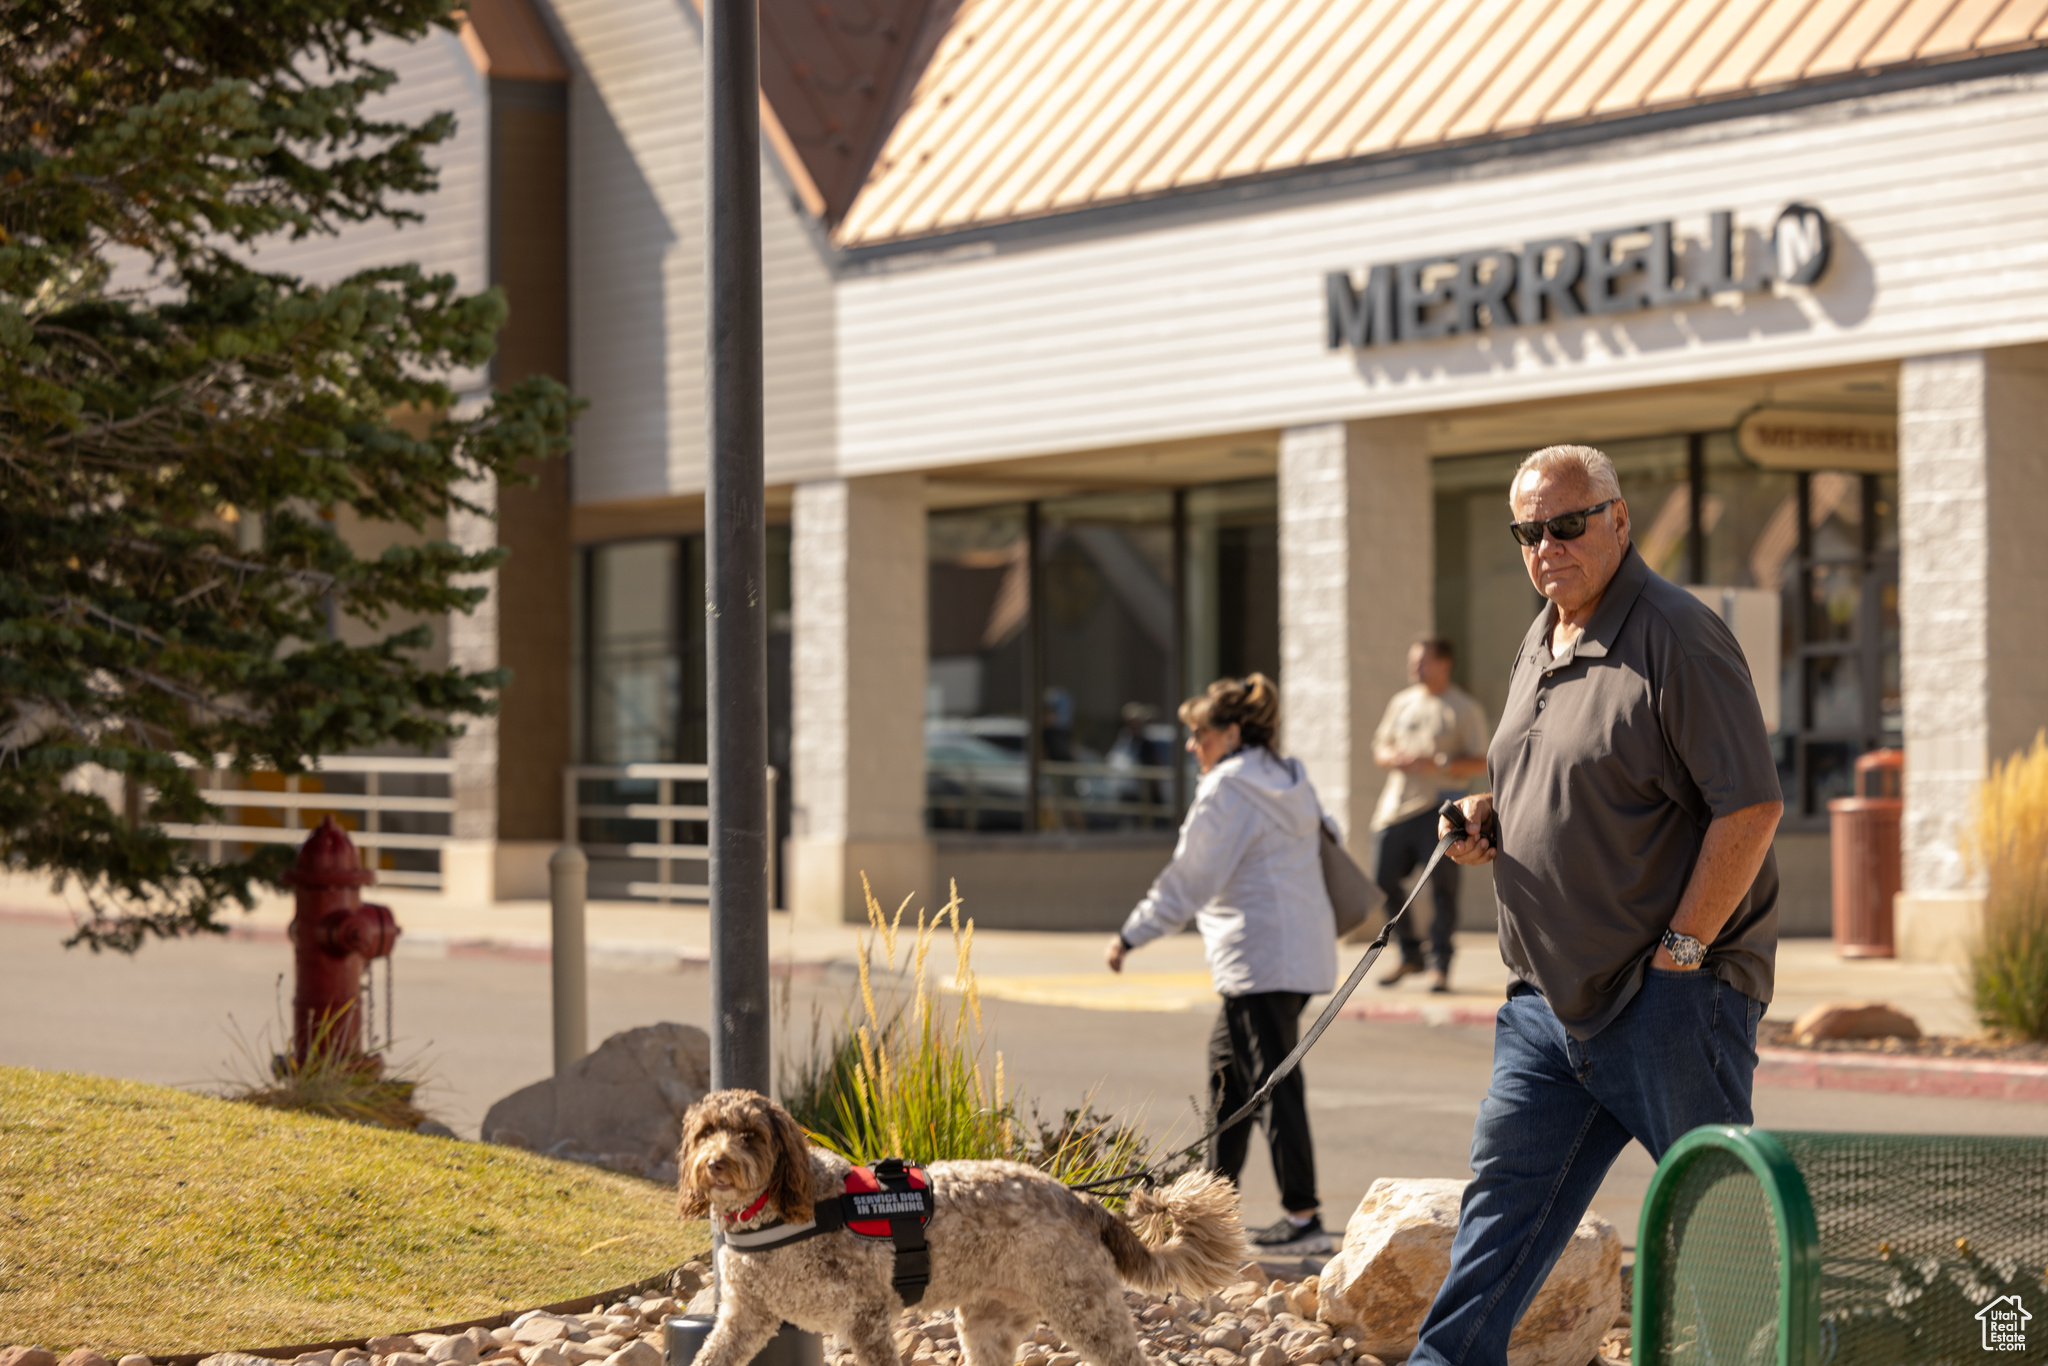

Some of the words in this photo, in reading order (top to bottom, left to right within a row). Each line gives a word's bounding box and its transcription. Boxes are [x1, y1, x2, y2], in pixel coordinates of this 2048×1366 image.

[1326, 209, 1771, 349] MERRELL
[853, 1193, 899, 1206] SERVICE
[899, 1191, 923, 1202] DOG
[856, 1204, 870, 1215] IN
[871, 1201, 925, 1214] TRAINING
